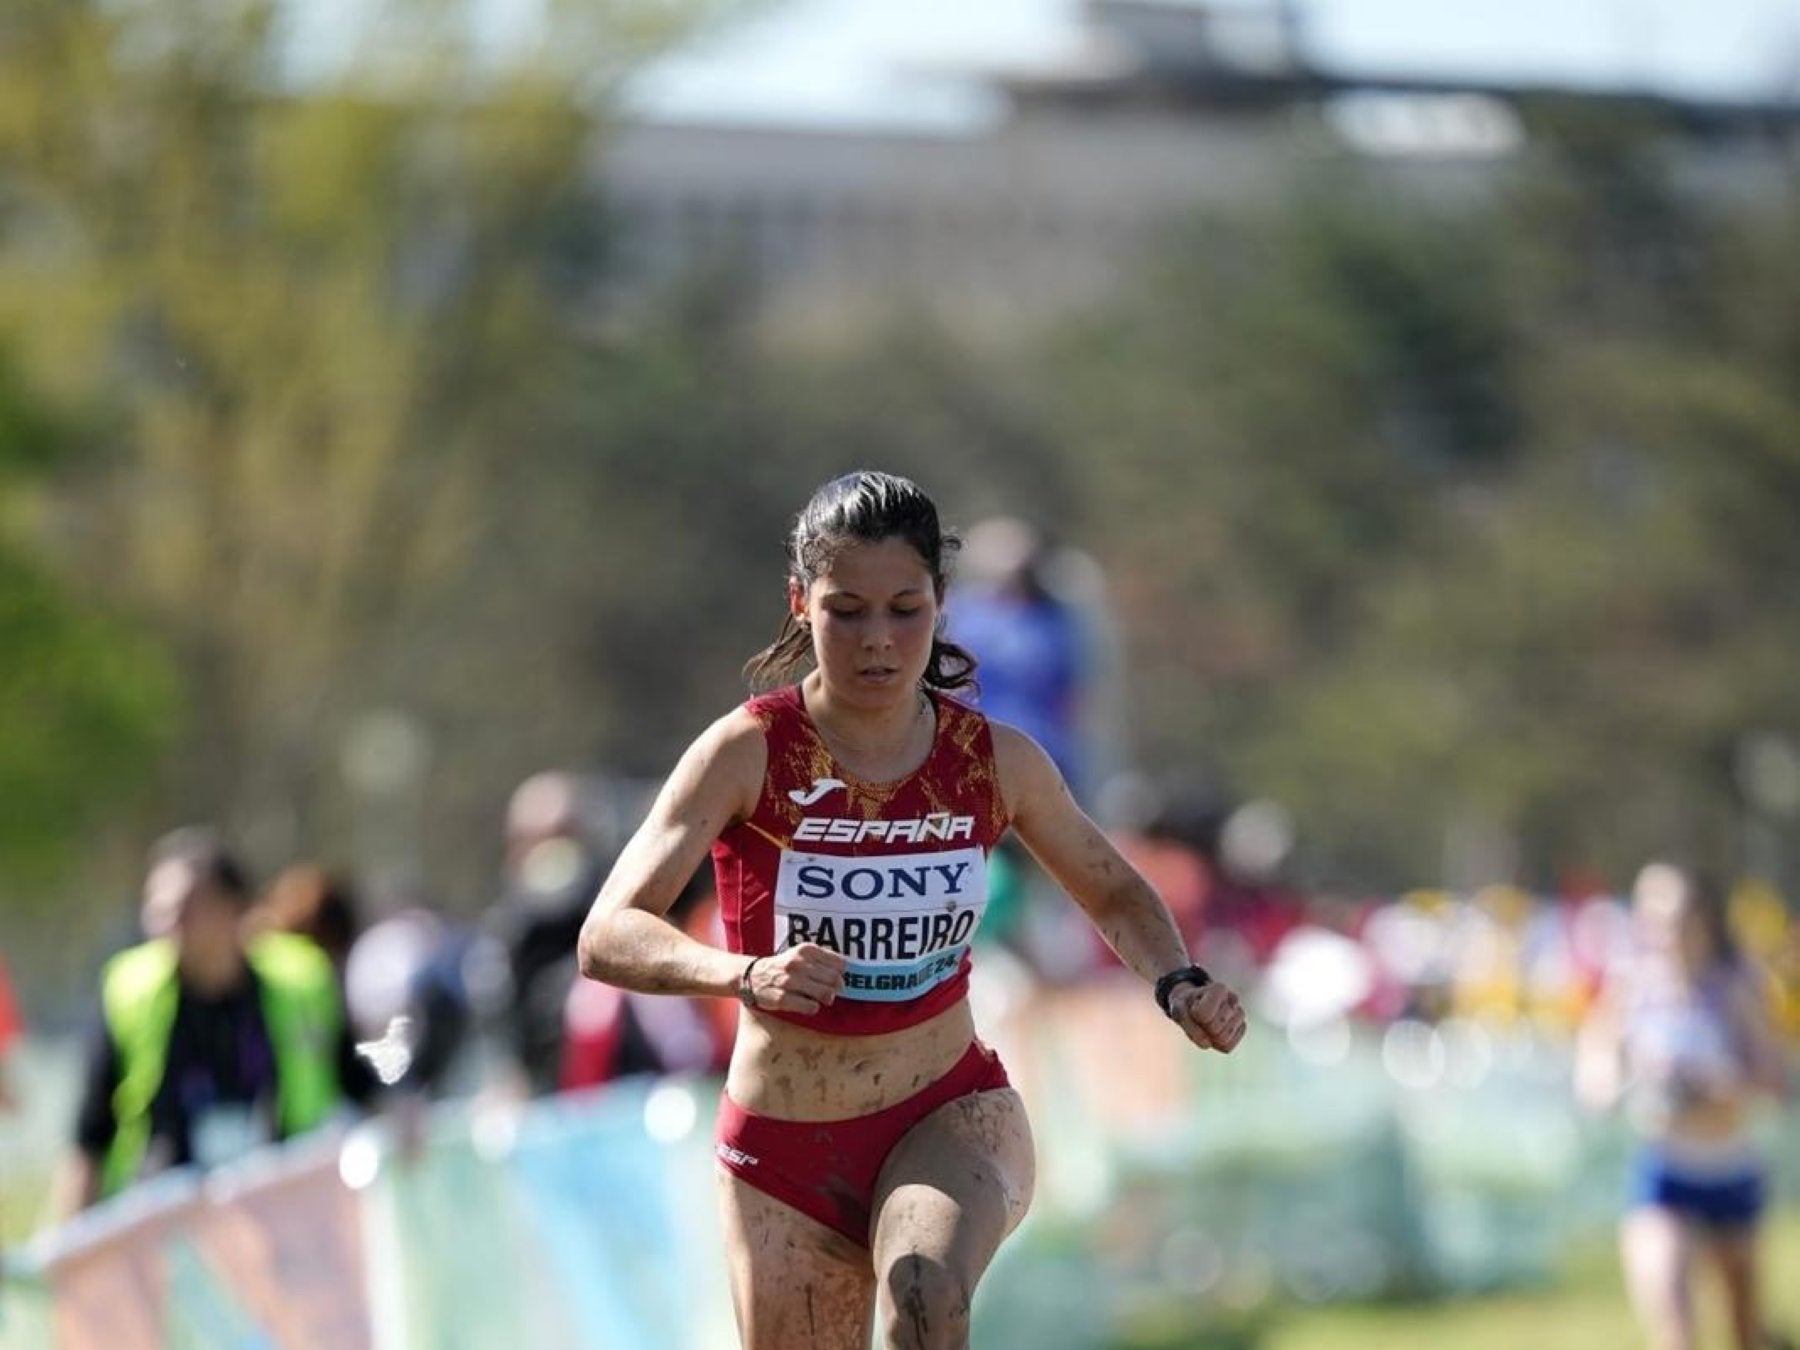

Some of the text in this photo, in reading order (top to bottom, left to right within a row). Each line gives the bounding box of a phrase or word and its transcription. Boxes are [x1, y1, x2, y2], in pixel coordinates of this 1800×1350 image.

[793, 812, 975, 843] ESPAÑA
[797, 862, 969, 900] SONY
[788, 909, 975, 960] BARREIRO
